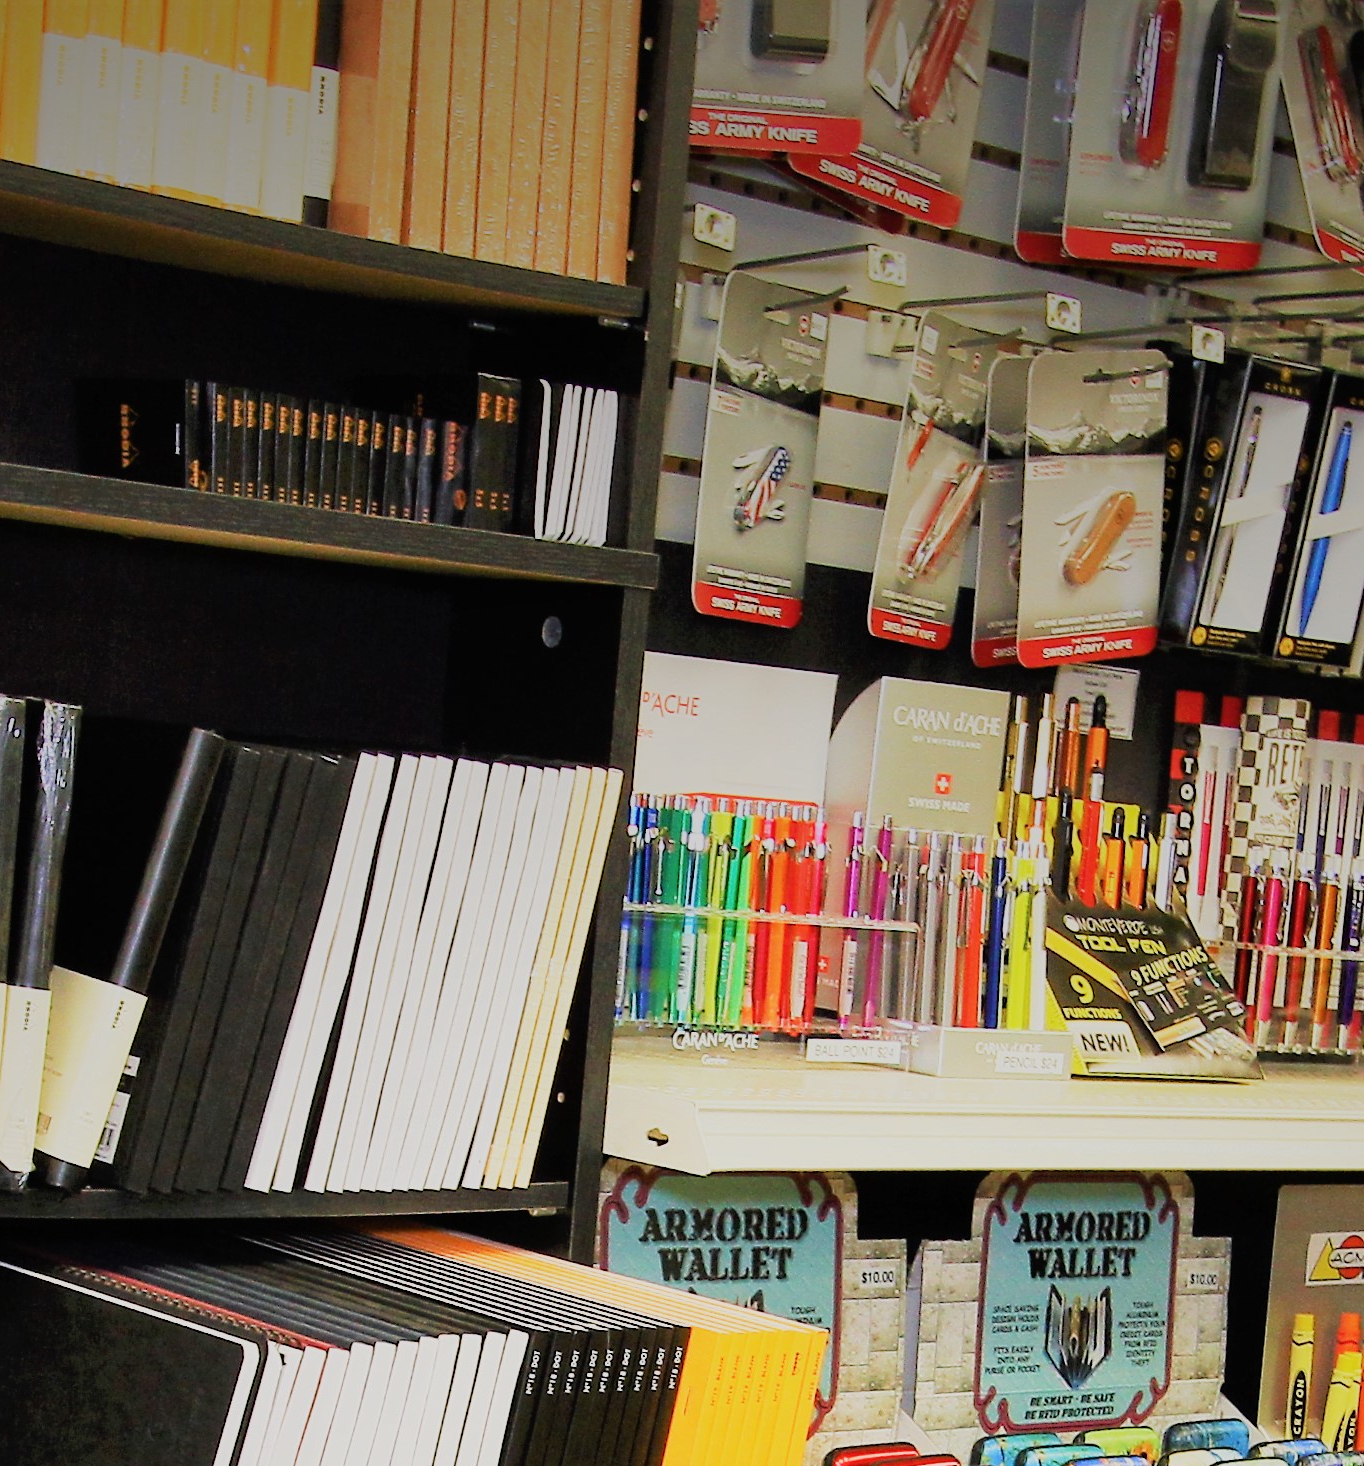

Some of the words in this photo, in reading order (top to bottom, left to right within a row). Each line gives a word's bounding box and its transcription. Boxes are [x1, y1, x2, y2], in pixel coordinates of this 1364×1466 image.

[714, 123, 765, 140] ARMY
[768, 126, 818, 144] KNIFE
[819, 158, 857, 184] SWISS
[858, 175, 895, 199] ARMY
[894, 187, 932, 213] KNIFE
[1111, 242, 1145, 258] SWISS
[1145, 244, 1182, 260] ARMY
[1182, 247, 1217, 263] KNIFE
[1043, 644, 1074, 659] SWISS
[1073, 641, 1104, 656] ARMY
[1103, 638, 1133, 652] KNIFE
[642, 691, 701, 718] D'ACHE
[893, 704, 950, 732] CARAN
[953, 711, 1002, 738] d'ACHE
[908, 795, 940, 810] SWISS
[941, 800, 971, 814] MADE
[1074, 934, 1126, 953] TOOL
[1127, 937, 1167, 956] PEN
[1130, 968, 1143, 987] 9
[1141, 945, 1209, 980] FUNCTIONS
[1069, 974, 1095, 1005] 9
[1062, 1006, 1123, 1021] FUNCTIONS
[814, 1043, 839, 1058] BALL
[841, 1044, 875, 1059] POINT
[1080, 1032, 1129, 1054] NEW!
[1003, 1055, 1039, 1070] PENCIL
[638, 1206, 809, 1242] ARMORED
[1013, 1210, 1151, 1243] ARMORED
[657, 1246, 794, 1282] WALLET
[1027, 1247, 1136, 1278] WALLET
[861, 1271, 894, 1284] $10.00
[1189, 1273, 1218, 1286] $10.00
[588, 1349, 598, 1368] DOT
[604, 1349, 614, 1367] DOT
[622, 1348, 631, 1366] DOT
[639, 1348, 649, 1366] DOT
[656, 1347, 666, 1365] DOT
[673, 1346, 684, 1364] DOT
[1293, 1379, 1306, 1435] CRAYON
